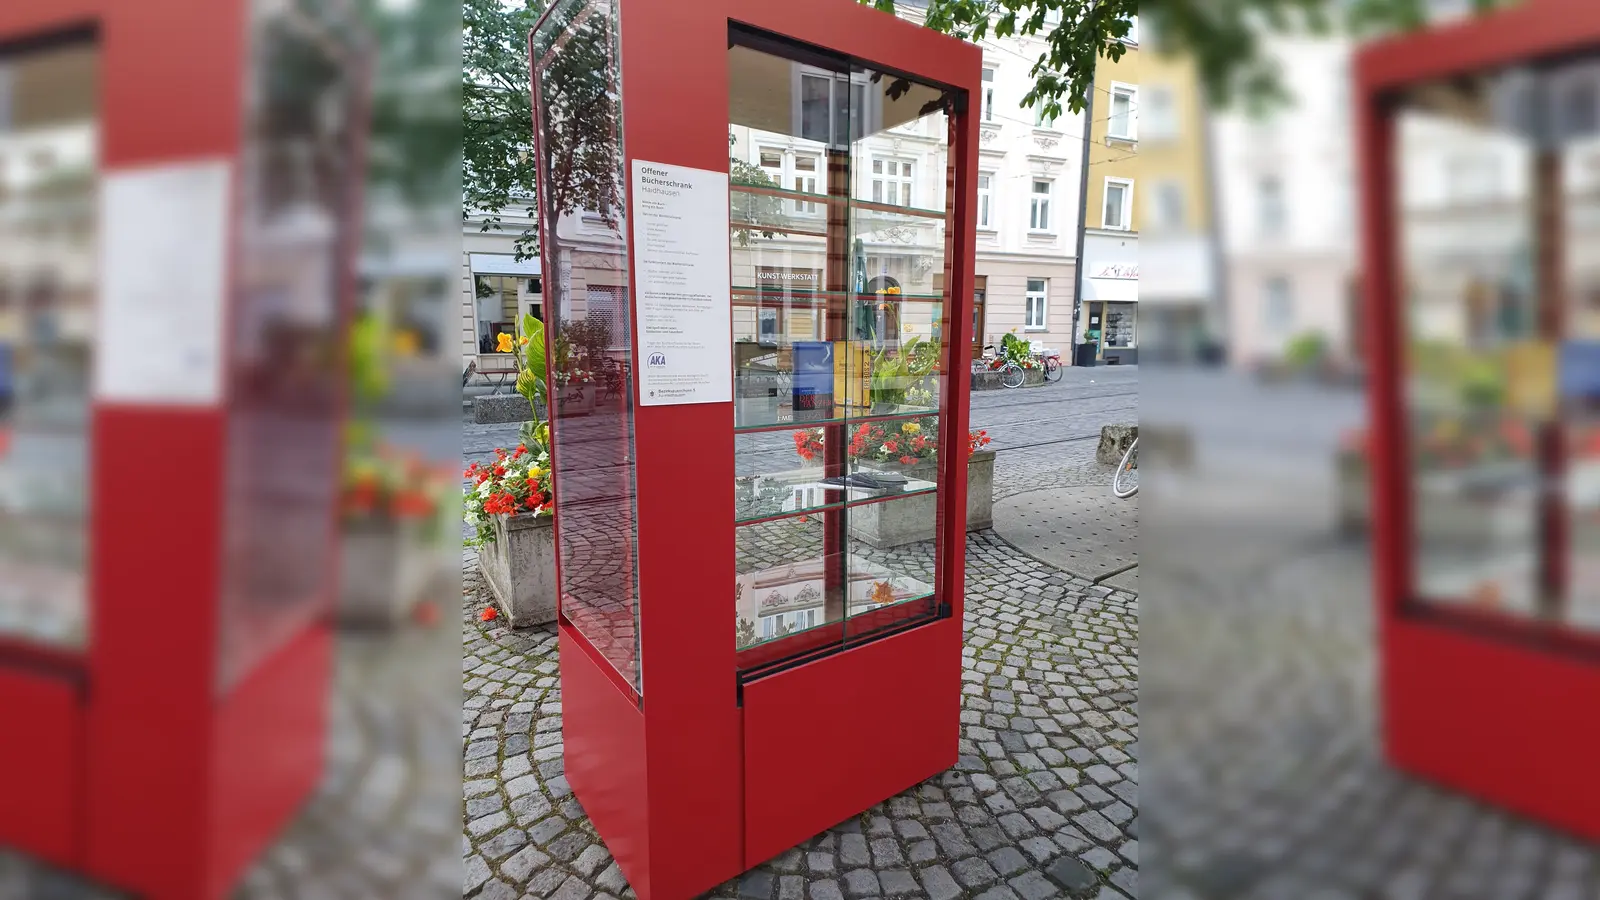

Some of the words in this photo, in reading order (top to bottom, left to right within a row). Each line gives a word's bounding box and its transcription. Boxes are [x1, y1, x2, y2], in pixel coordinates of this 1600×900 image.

[641, 167, 668, 176] Offener
[642, 176, 692, 189] Bücherschrank
[642, 186, 680, 196] Haidhausen
[650, 355, 666, 365] AKA
